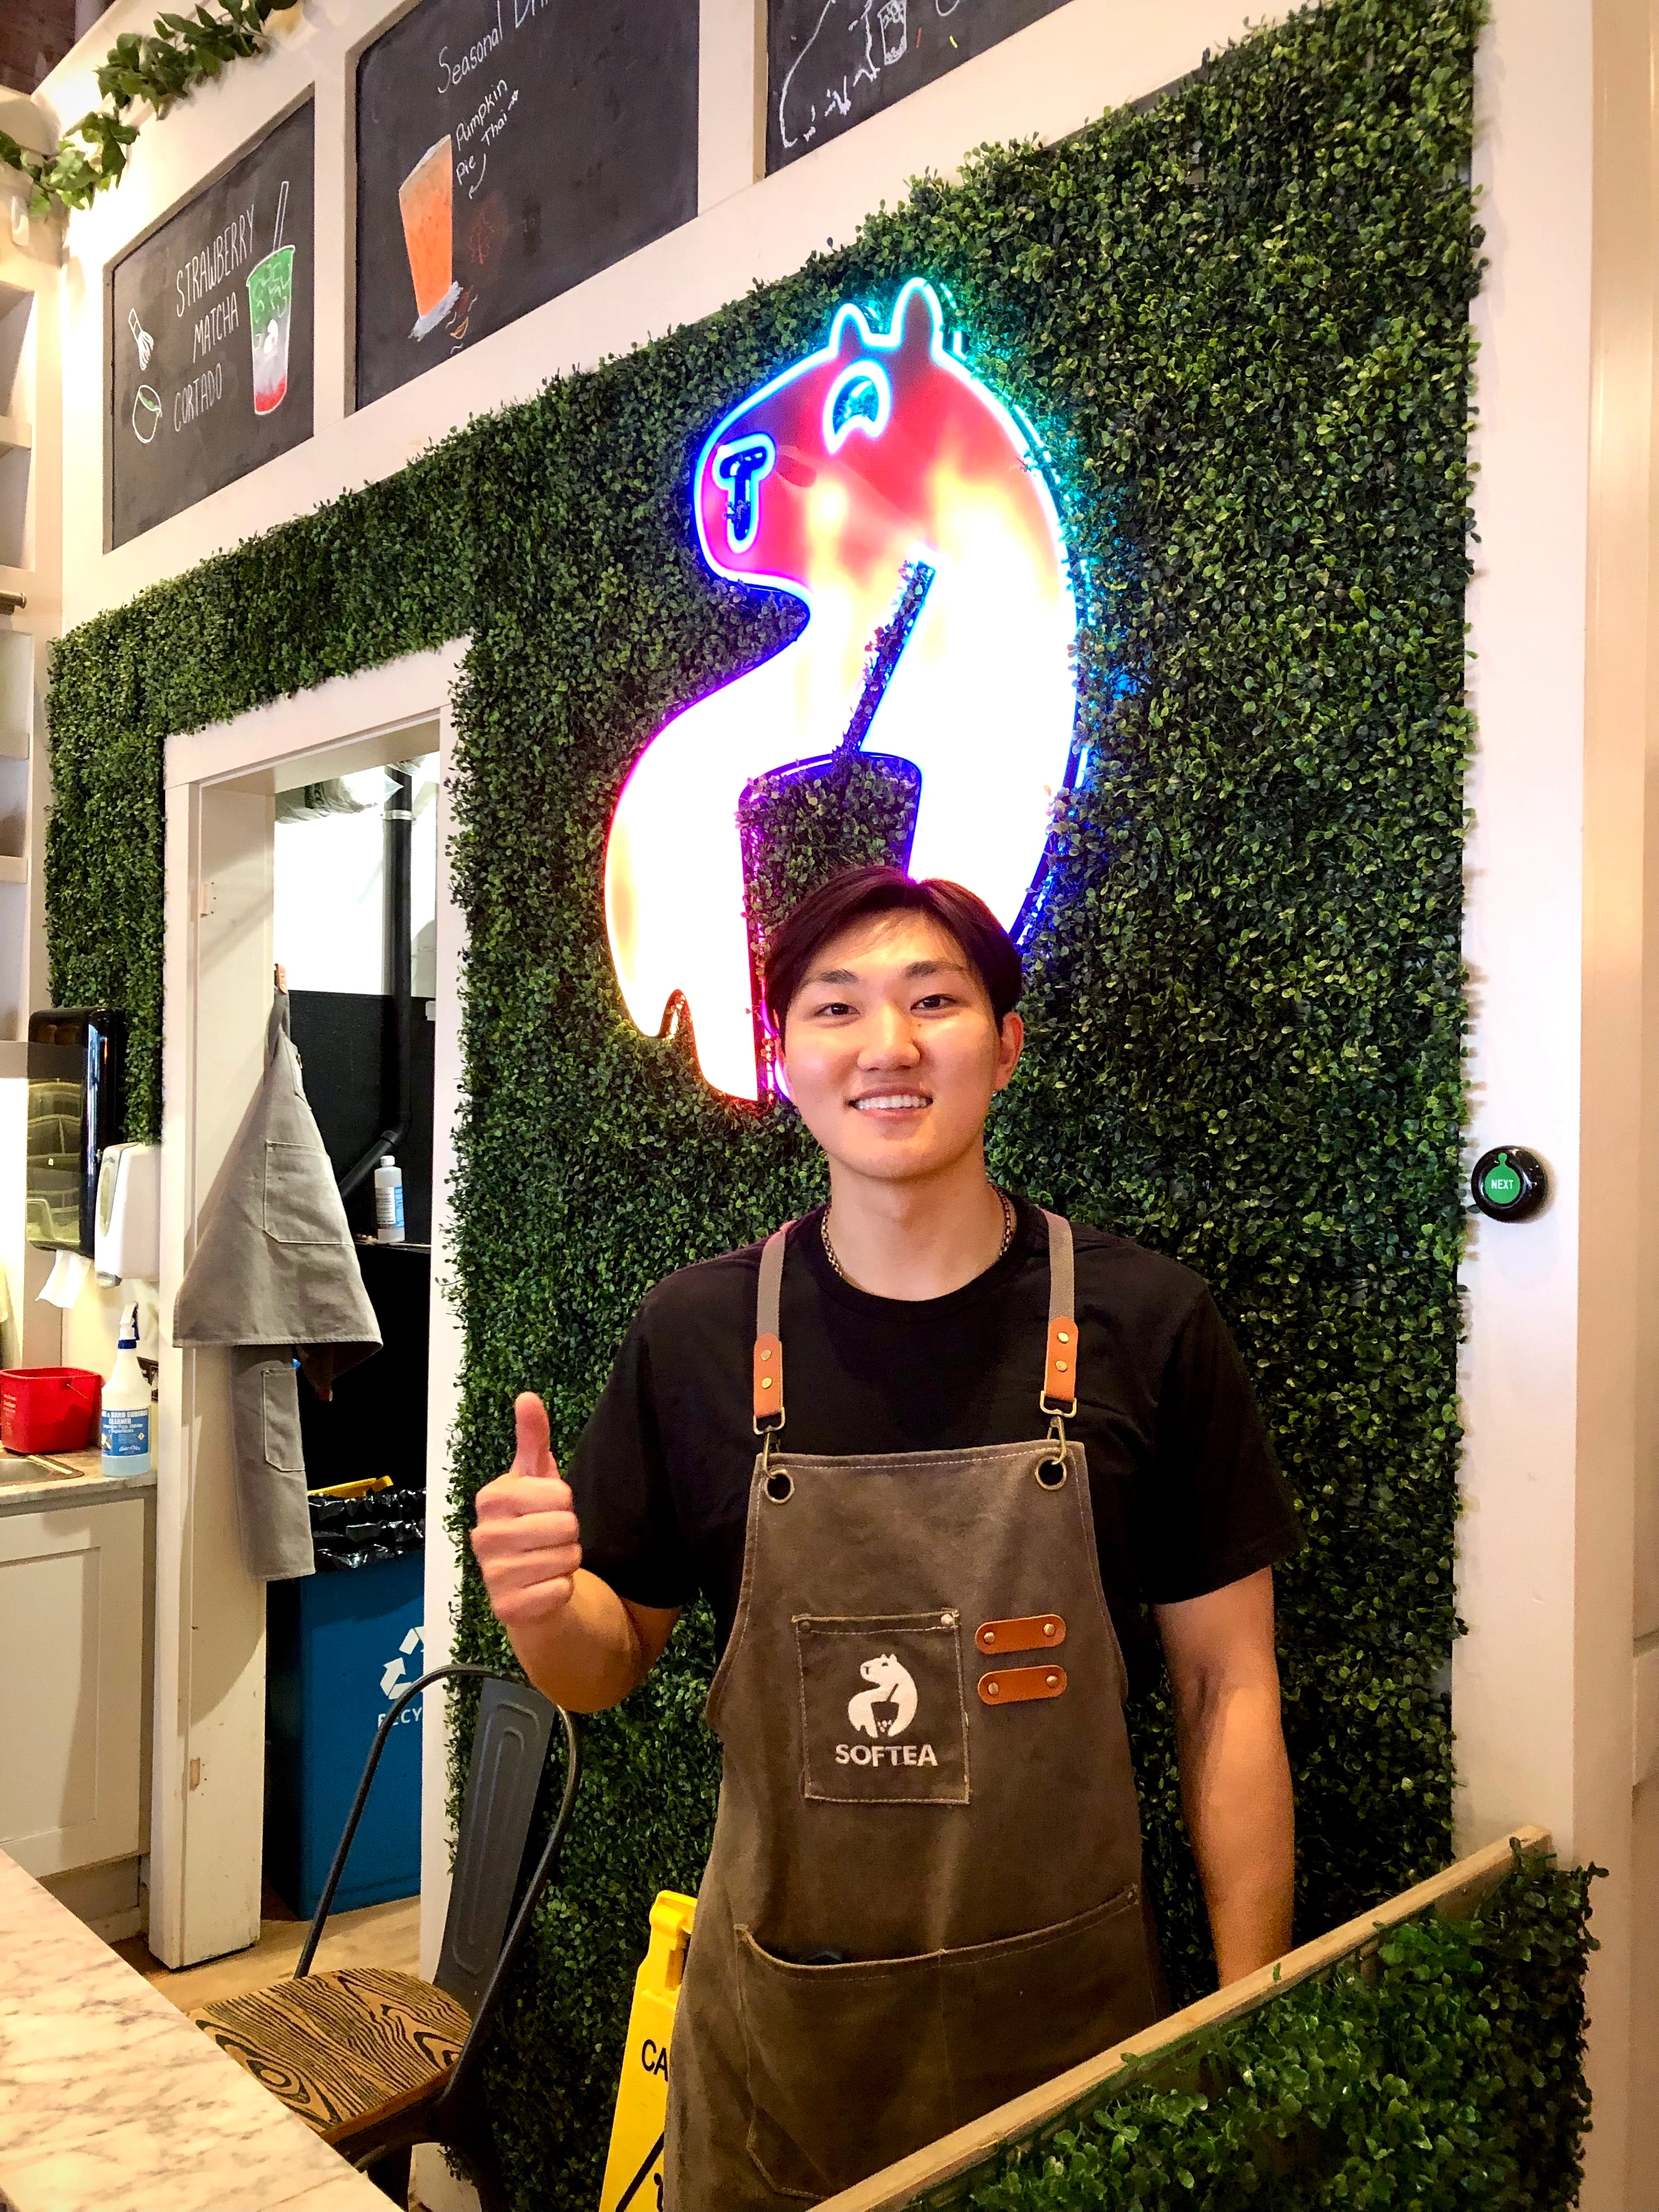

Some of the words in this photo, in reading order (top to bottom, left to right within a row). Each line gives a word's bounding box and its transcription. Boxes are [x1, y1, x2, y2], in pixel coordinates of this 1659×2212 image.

[437, 0, 503, 93] Seasonal
[456, 80, 508, 151] Pumpkin
[480, 109, 507, 146] Thai
[176, 204, 255, 318] STRAWBERRY
[193, 291, 239, 363] MATCHA
[174, 363, 222, 432] CORTADO
[1491, 1179, 1514, 1190] NEXT
[834, 1743, 938, 1767] SOFTEA
